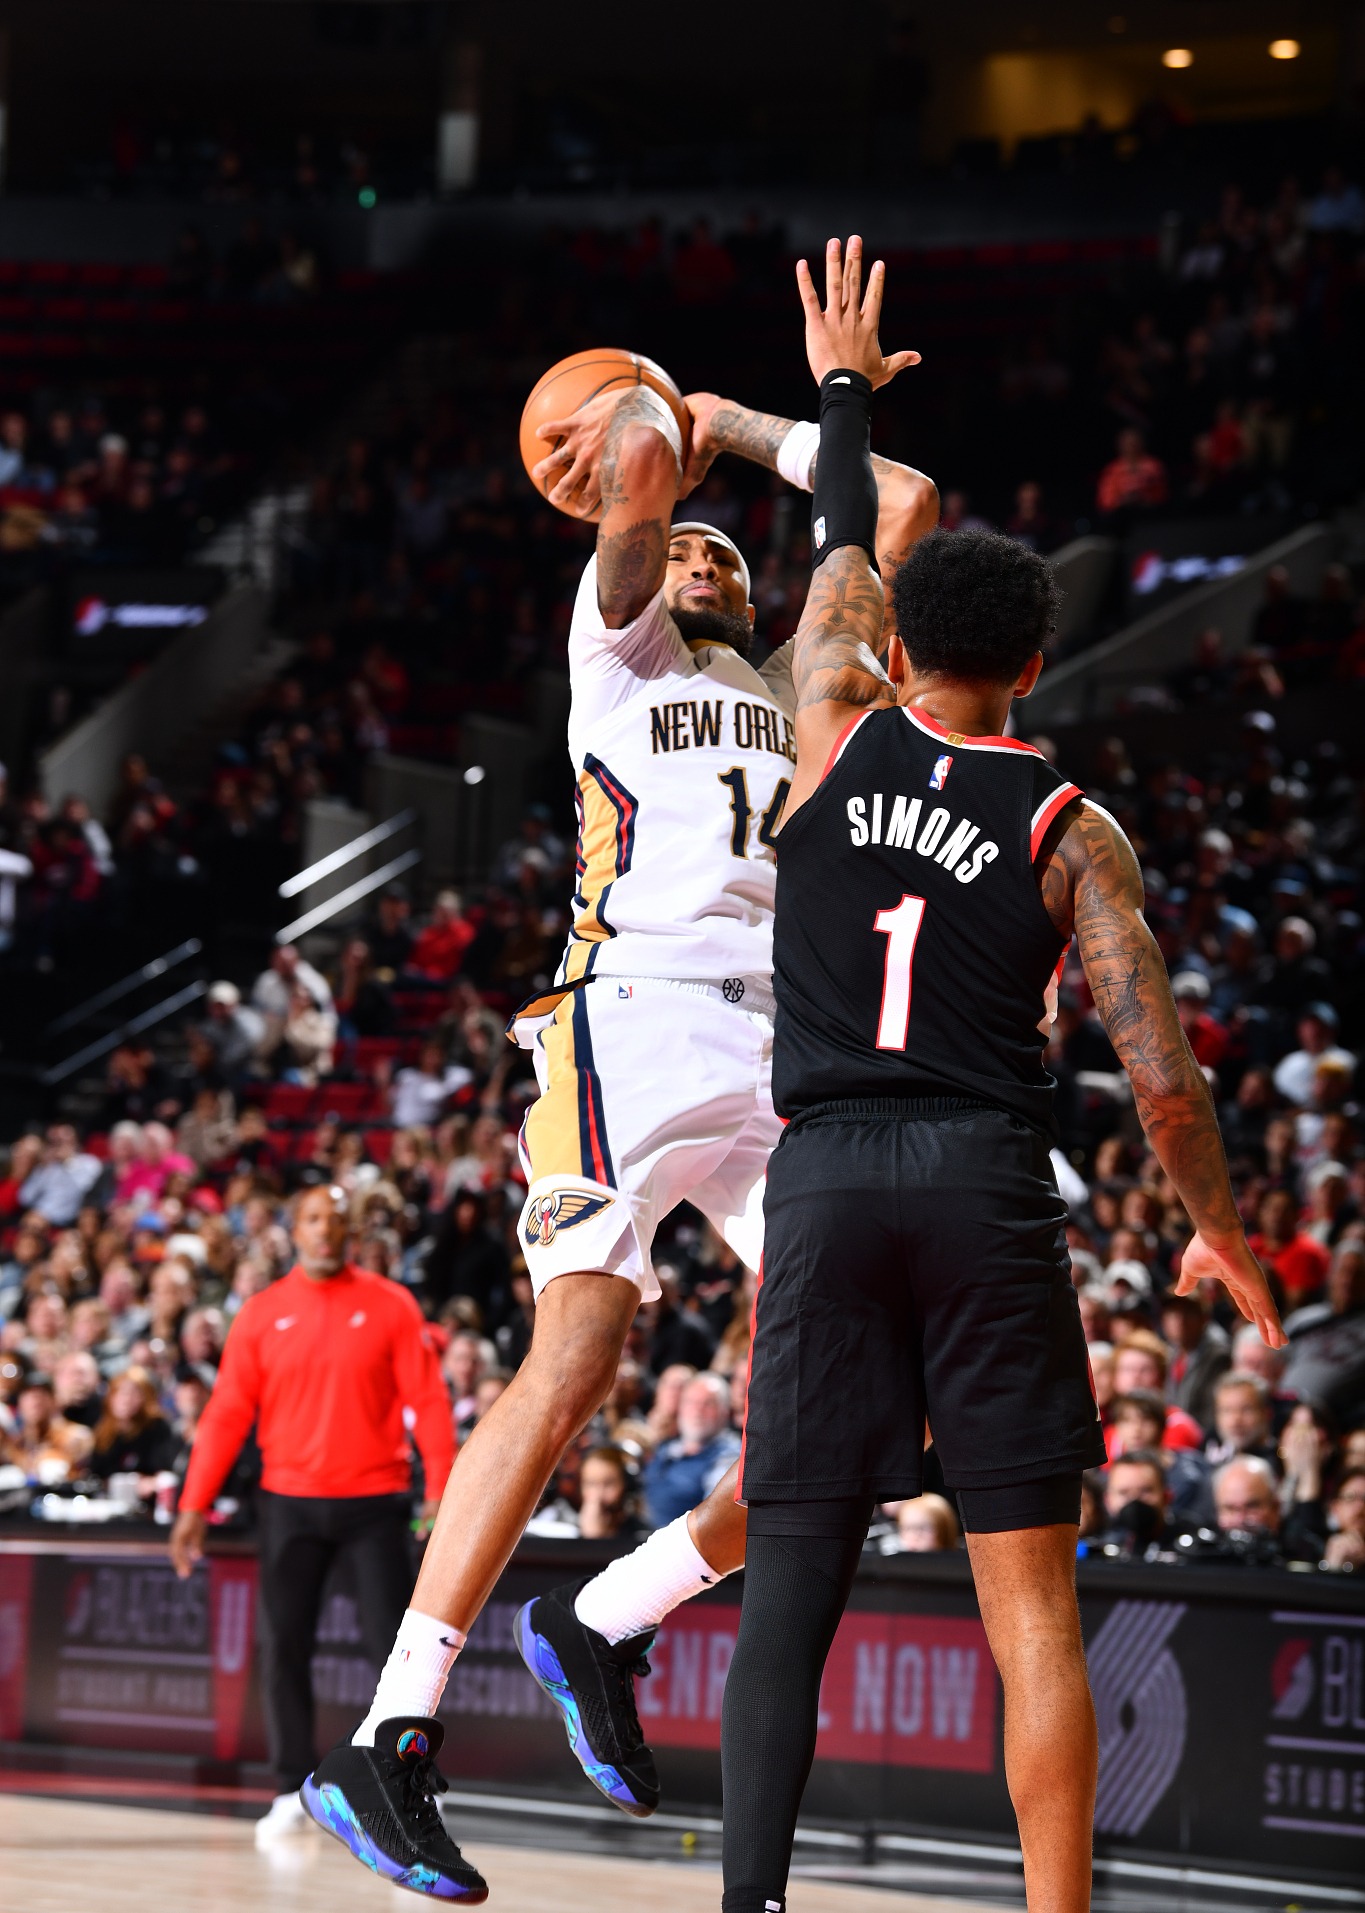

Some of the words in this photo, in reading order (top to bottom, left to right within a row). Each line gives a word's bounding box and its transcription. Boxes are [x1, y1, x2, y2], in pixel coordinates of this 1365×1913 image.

[650, 700, 724, 755] NEW
[847, 793, 999, 883] SIMONS
[873, 893, 927, 1051] 1
[853, 1642, 979, 1741] NOW
